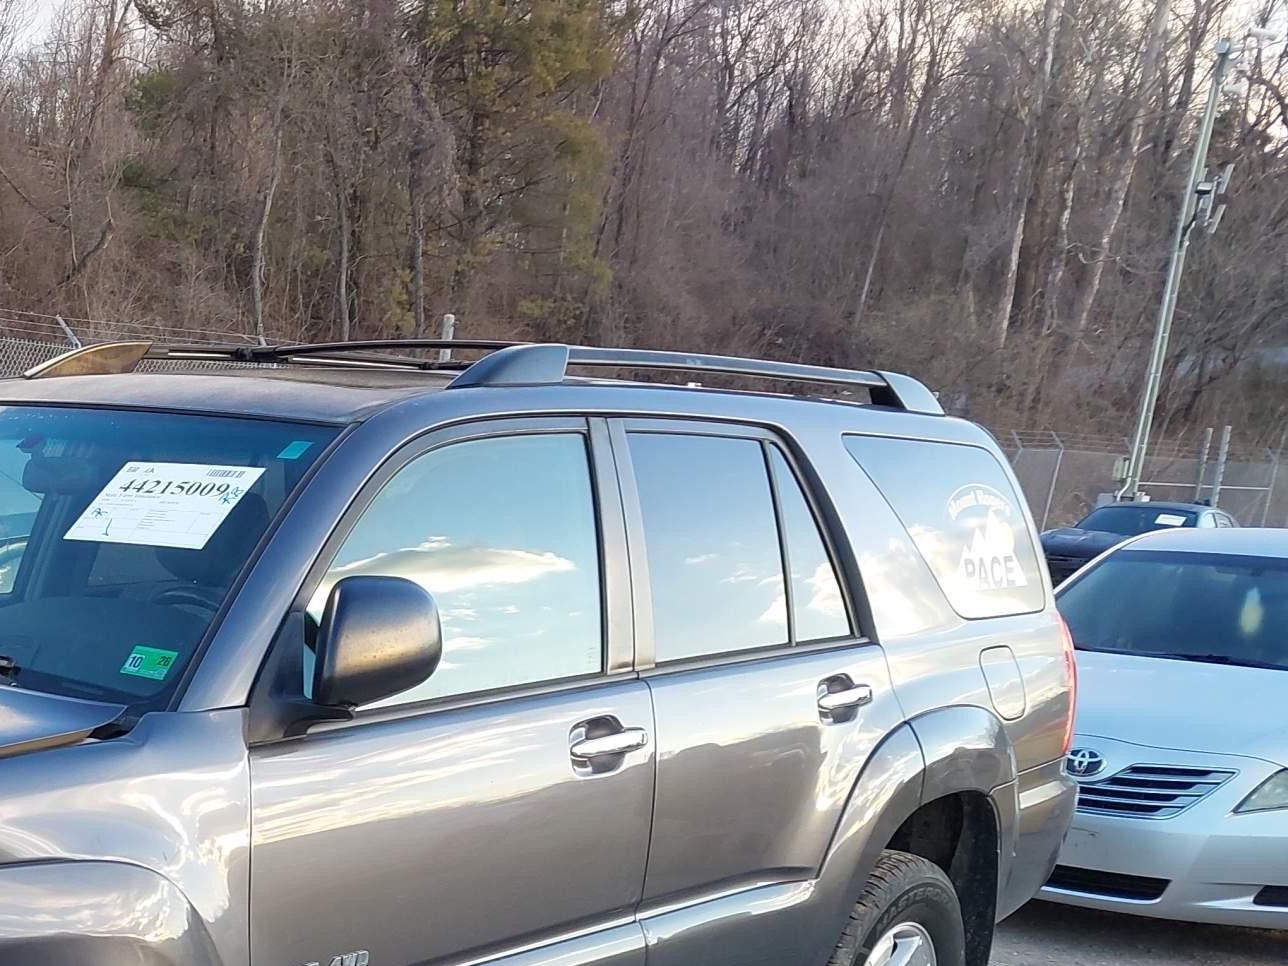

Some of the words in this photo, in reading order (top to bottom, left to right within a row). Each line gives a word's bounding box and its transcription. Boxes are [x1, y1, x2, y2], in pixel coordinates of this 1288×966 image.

[119, 478, 230, 497] 44215009
[964, 555, 1017, 589] PACE
[128, 655, 143, 668] 10
[157, 655, 172, 667] 26
